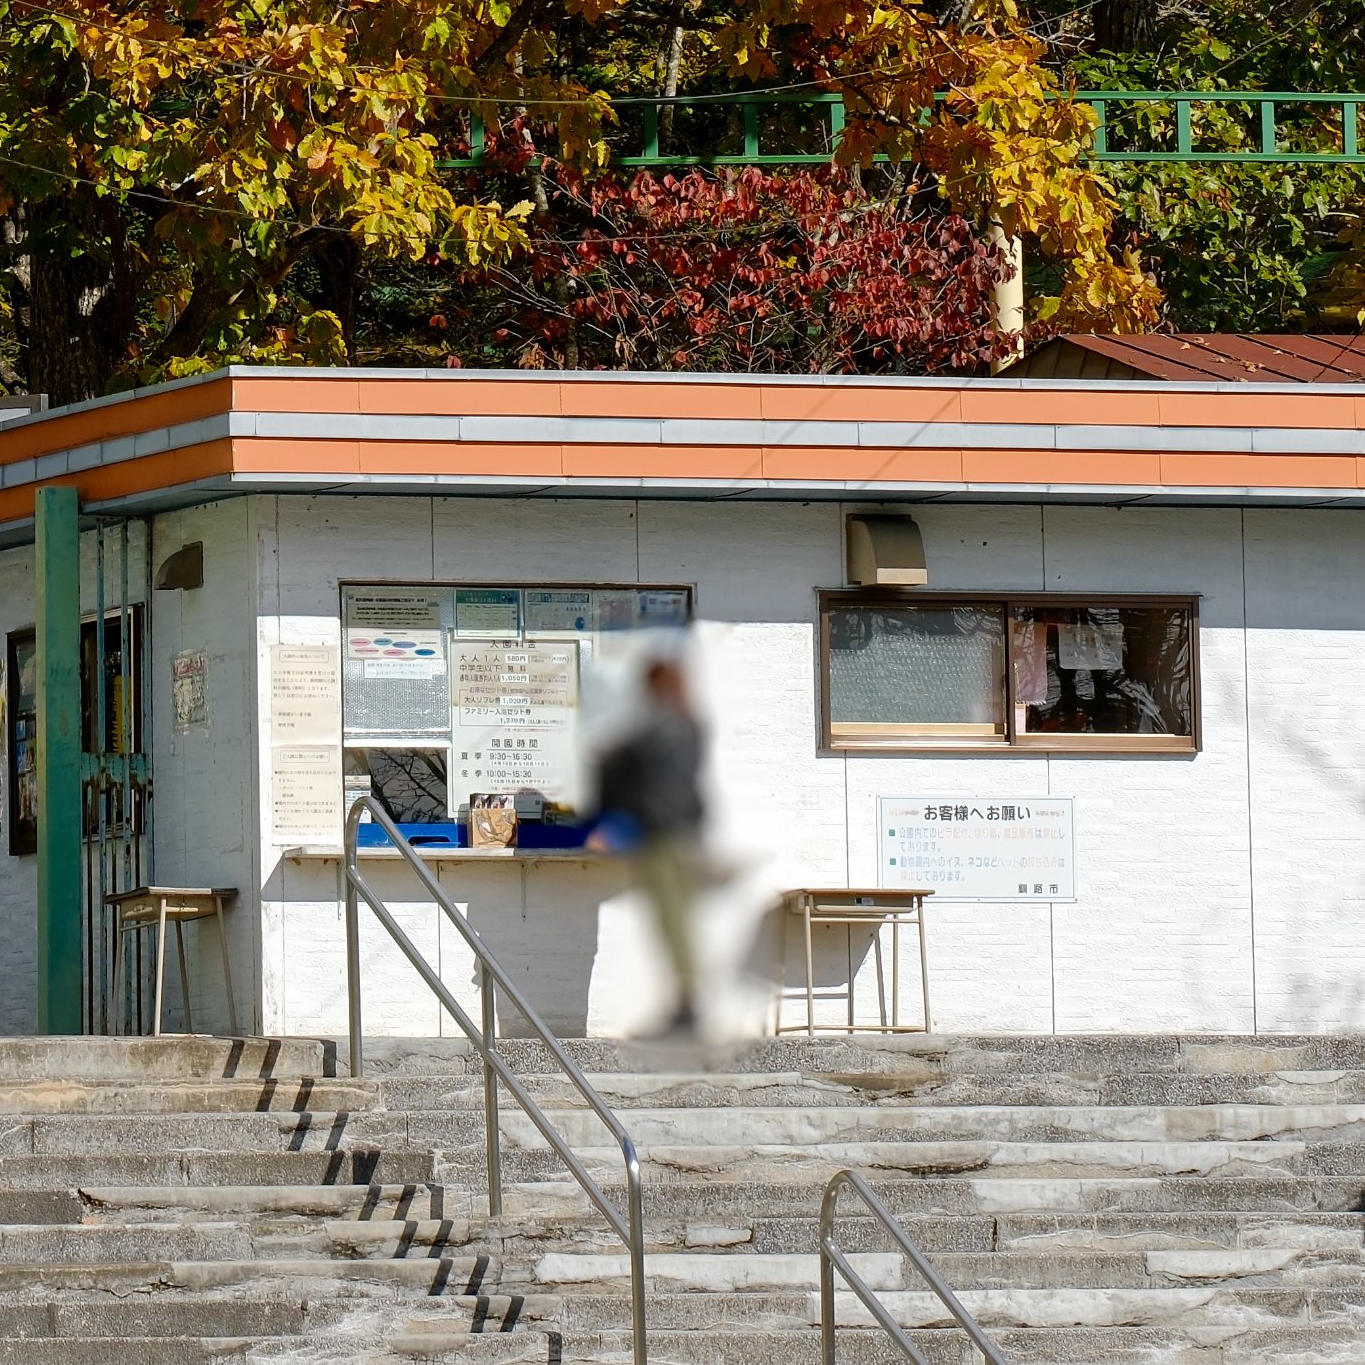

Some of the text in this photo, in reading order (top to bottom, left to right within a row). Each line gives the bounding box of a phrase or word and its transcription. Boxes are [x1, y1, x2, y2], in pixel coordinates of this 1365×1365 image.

[491, 738, 538, 748] 開園時間
[923, 805, 1032, 822] お客様へお願い
[1017, 883, 1059, 894] 釧路市
